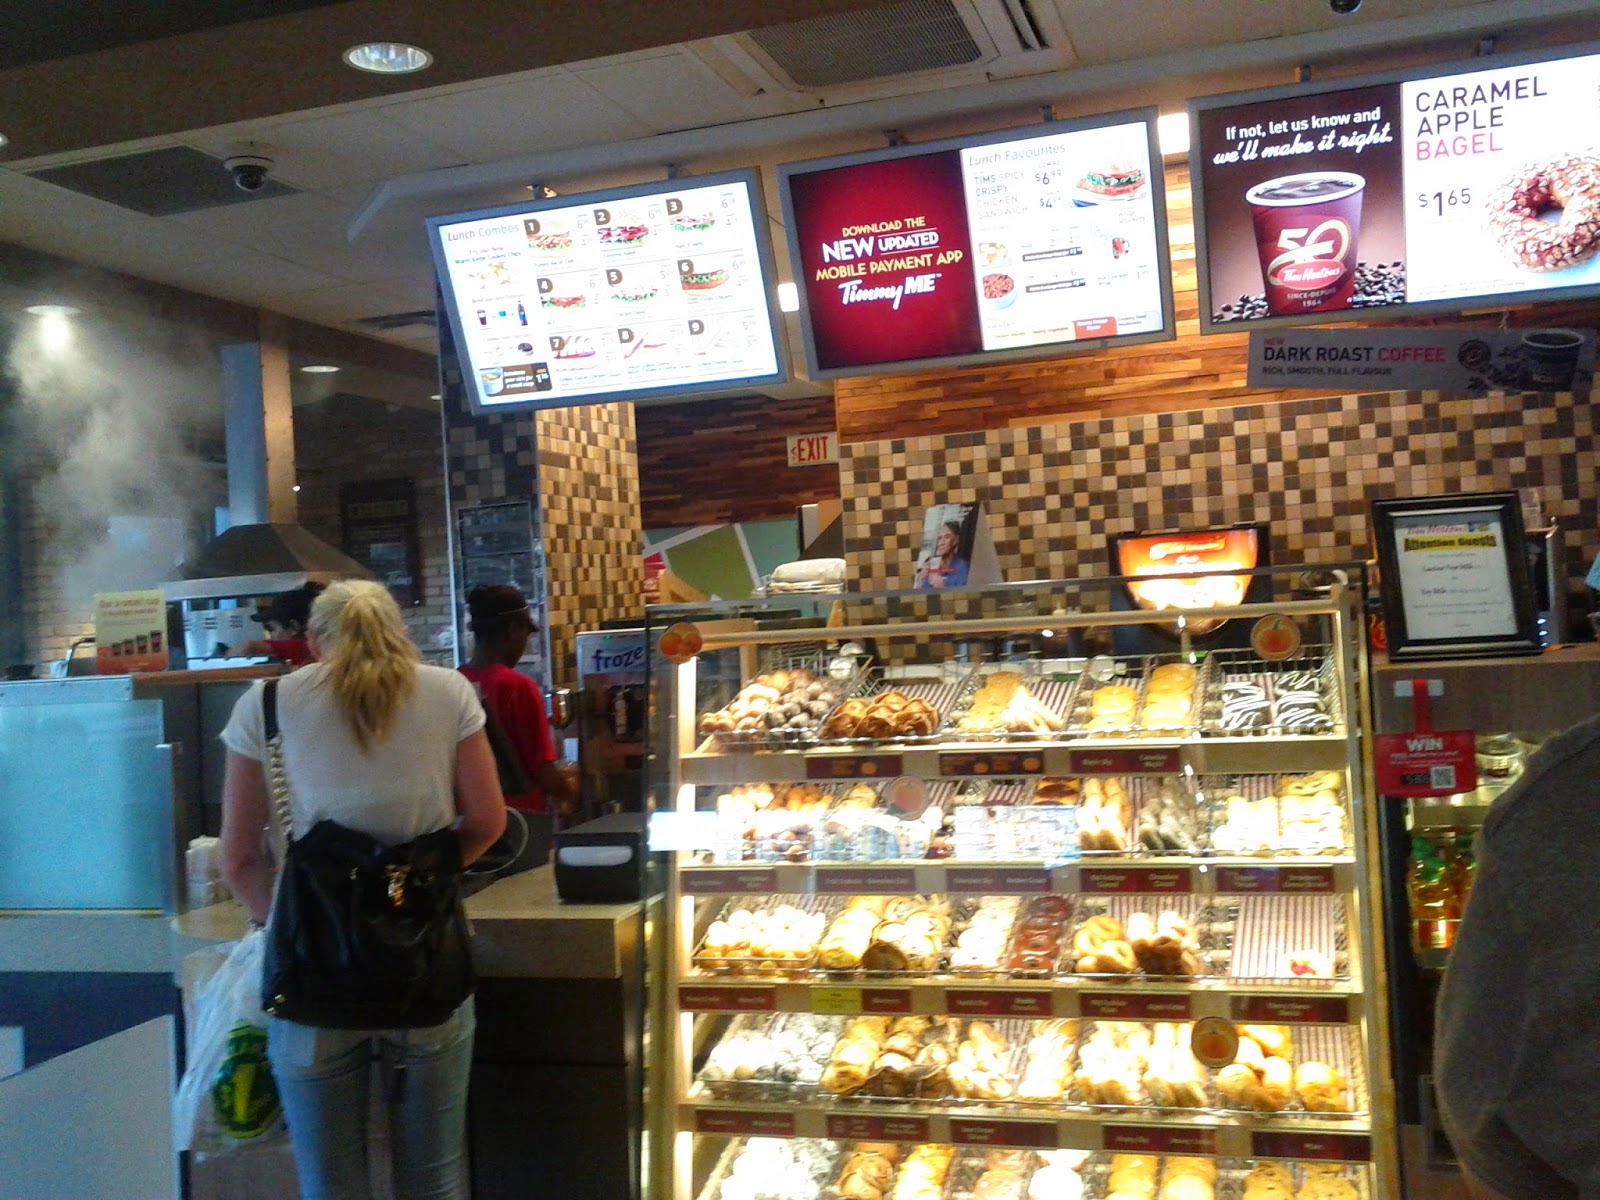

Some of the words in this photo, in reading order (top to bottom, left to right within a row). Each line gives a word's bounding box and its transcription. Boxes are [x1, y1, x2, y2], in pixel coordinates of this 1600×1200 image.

[1416, 76, 1547, 112] CARAMEL
[1226, 126, 1237, 140] If
[1239, 124, 1266, 138] not,
[1269, 120, 1288, 135] let
[1291, 119, 1309, 132] us
[1312, 113, 1350, 129] know
[1353, 106, 1381, 124] and
[1416, 106, 1504, 137] APPLE
[968, 153, 1001, 167] Lunch
[1005, 144, 1066, 161] Favourites
[1213, 139, 1259, 165] we'll
[1261, 133, 1314, 159] make
[1317, 129, 1336, 151] it
[1338, 122, 1393, 154] right.
[1416, 132, 1502, 161] BAGEL
[974, 174, 997, 185] TIMS
[976, 185, 1008, 197] CRISPY
[448, 228, 476, 242] Lunch
[478, 223, 520, 238] Combos
[842, 219, 902, 238] DOWNLOAD
[904, 215, 926, 228] THE
[822, 235, 875, 264] NEW
[878, 231, 940, 252] UPDATED
[816, 263, 867, 281] MOBILE
[870, 253, 934, 274] PAYMENT
[936, 250, 963, 266] APP
[1283, 268, 1302, 282] Tim
[1301, 266, 1340, 281] Hortons
[1264, 347, 1312, 362] DARK
[1315, 347, 1374, 362] ROAST
[1377, 347, 1447, 363] COFFEE
[797, 436, 828, 462] EXIT
[1406, 737, 1443, 751] WIN
